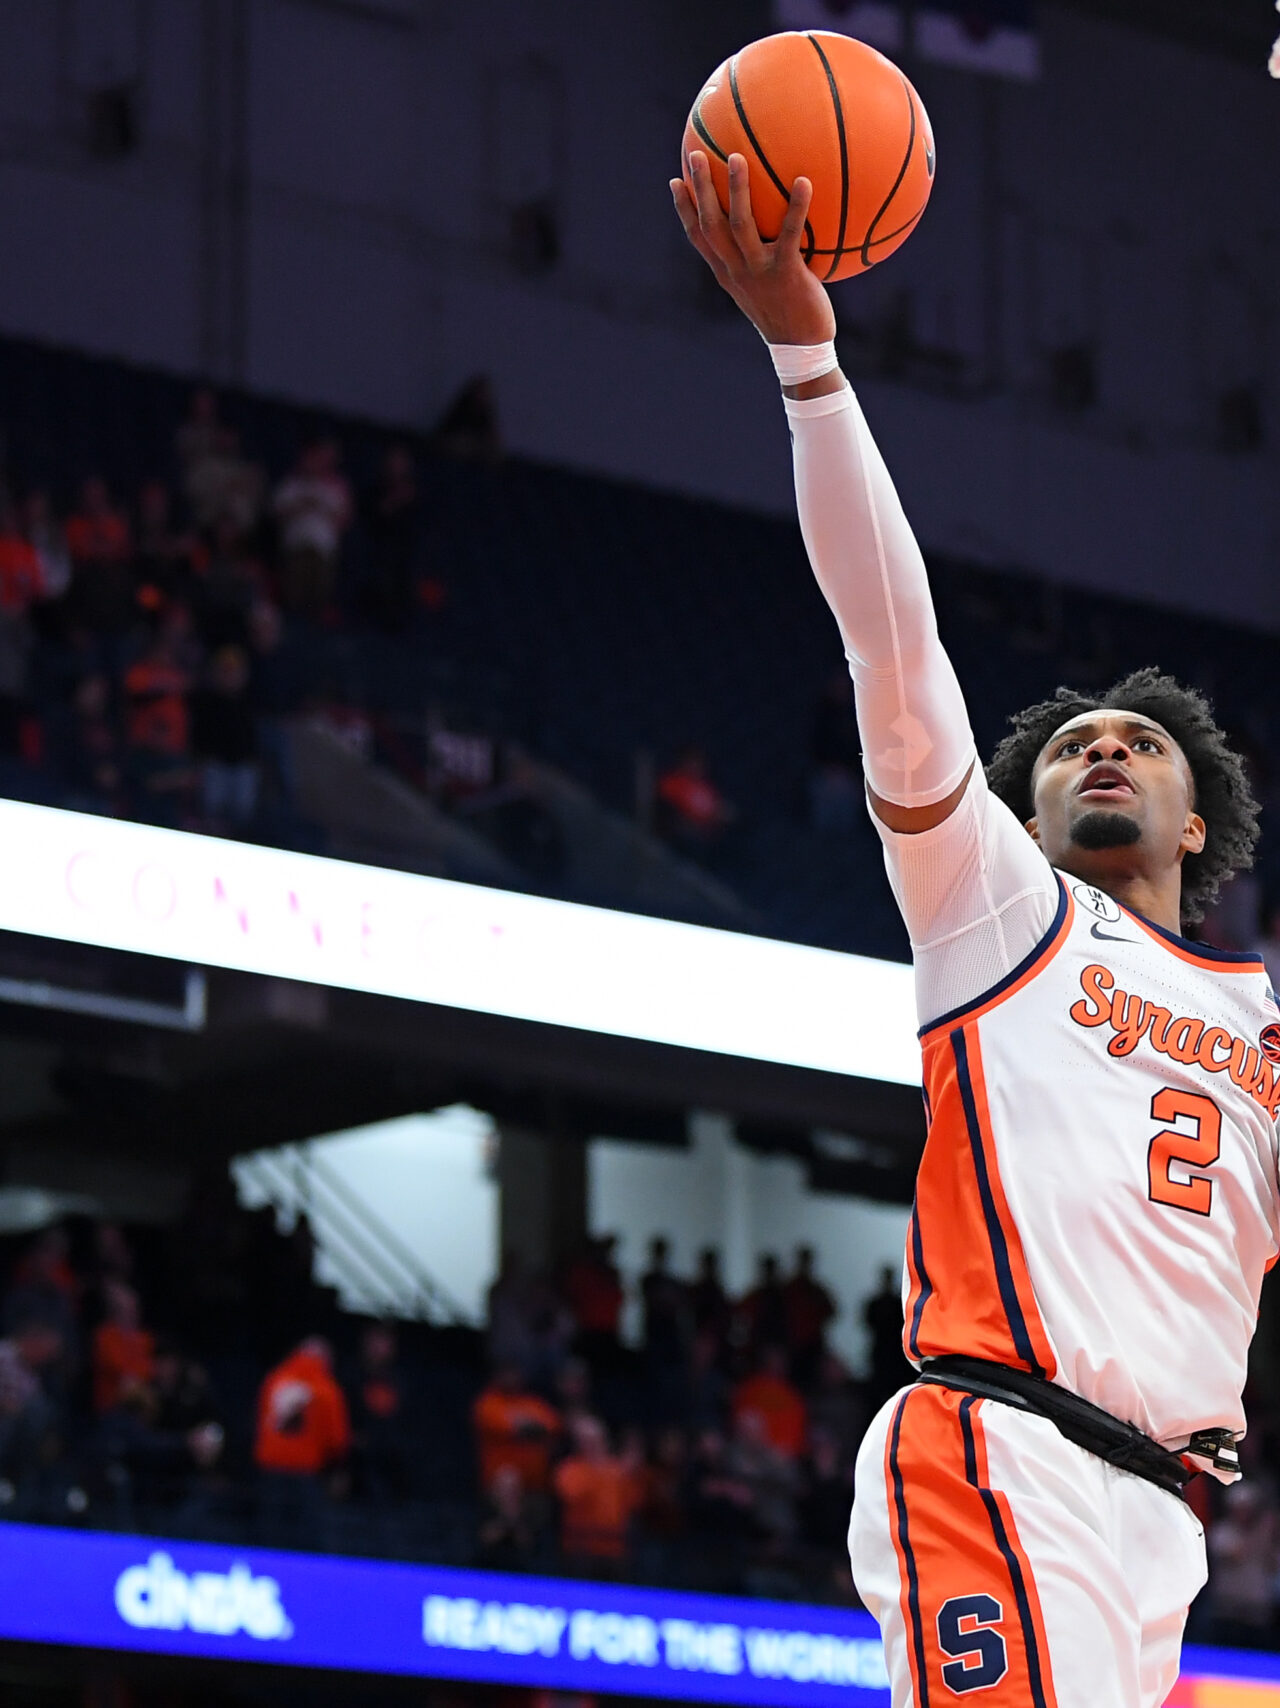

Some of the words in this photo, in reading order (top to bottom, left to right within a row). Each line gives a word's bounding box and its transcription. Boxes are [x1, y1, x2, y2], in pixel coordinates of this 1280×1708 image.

[1091, 898, 1107, 915] 21
[1148, 1086, 1222, 1217] 2
[422, 1595, 567, 1657] READY
[569, 1609, 659, 1668] FOR
[660, 1617, 744, 1675] THE
[936, 1592, 1008, 1695] S
